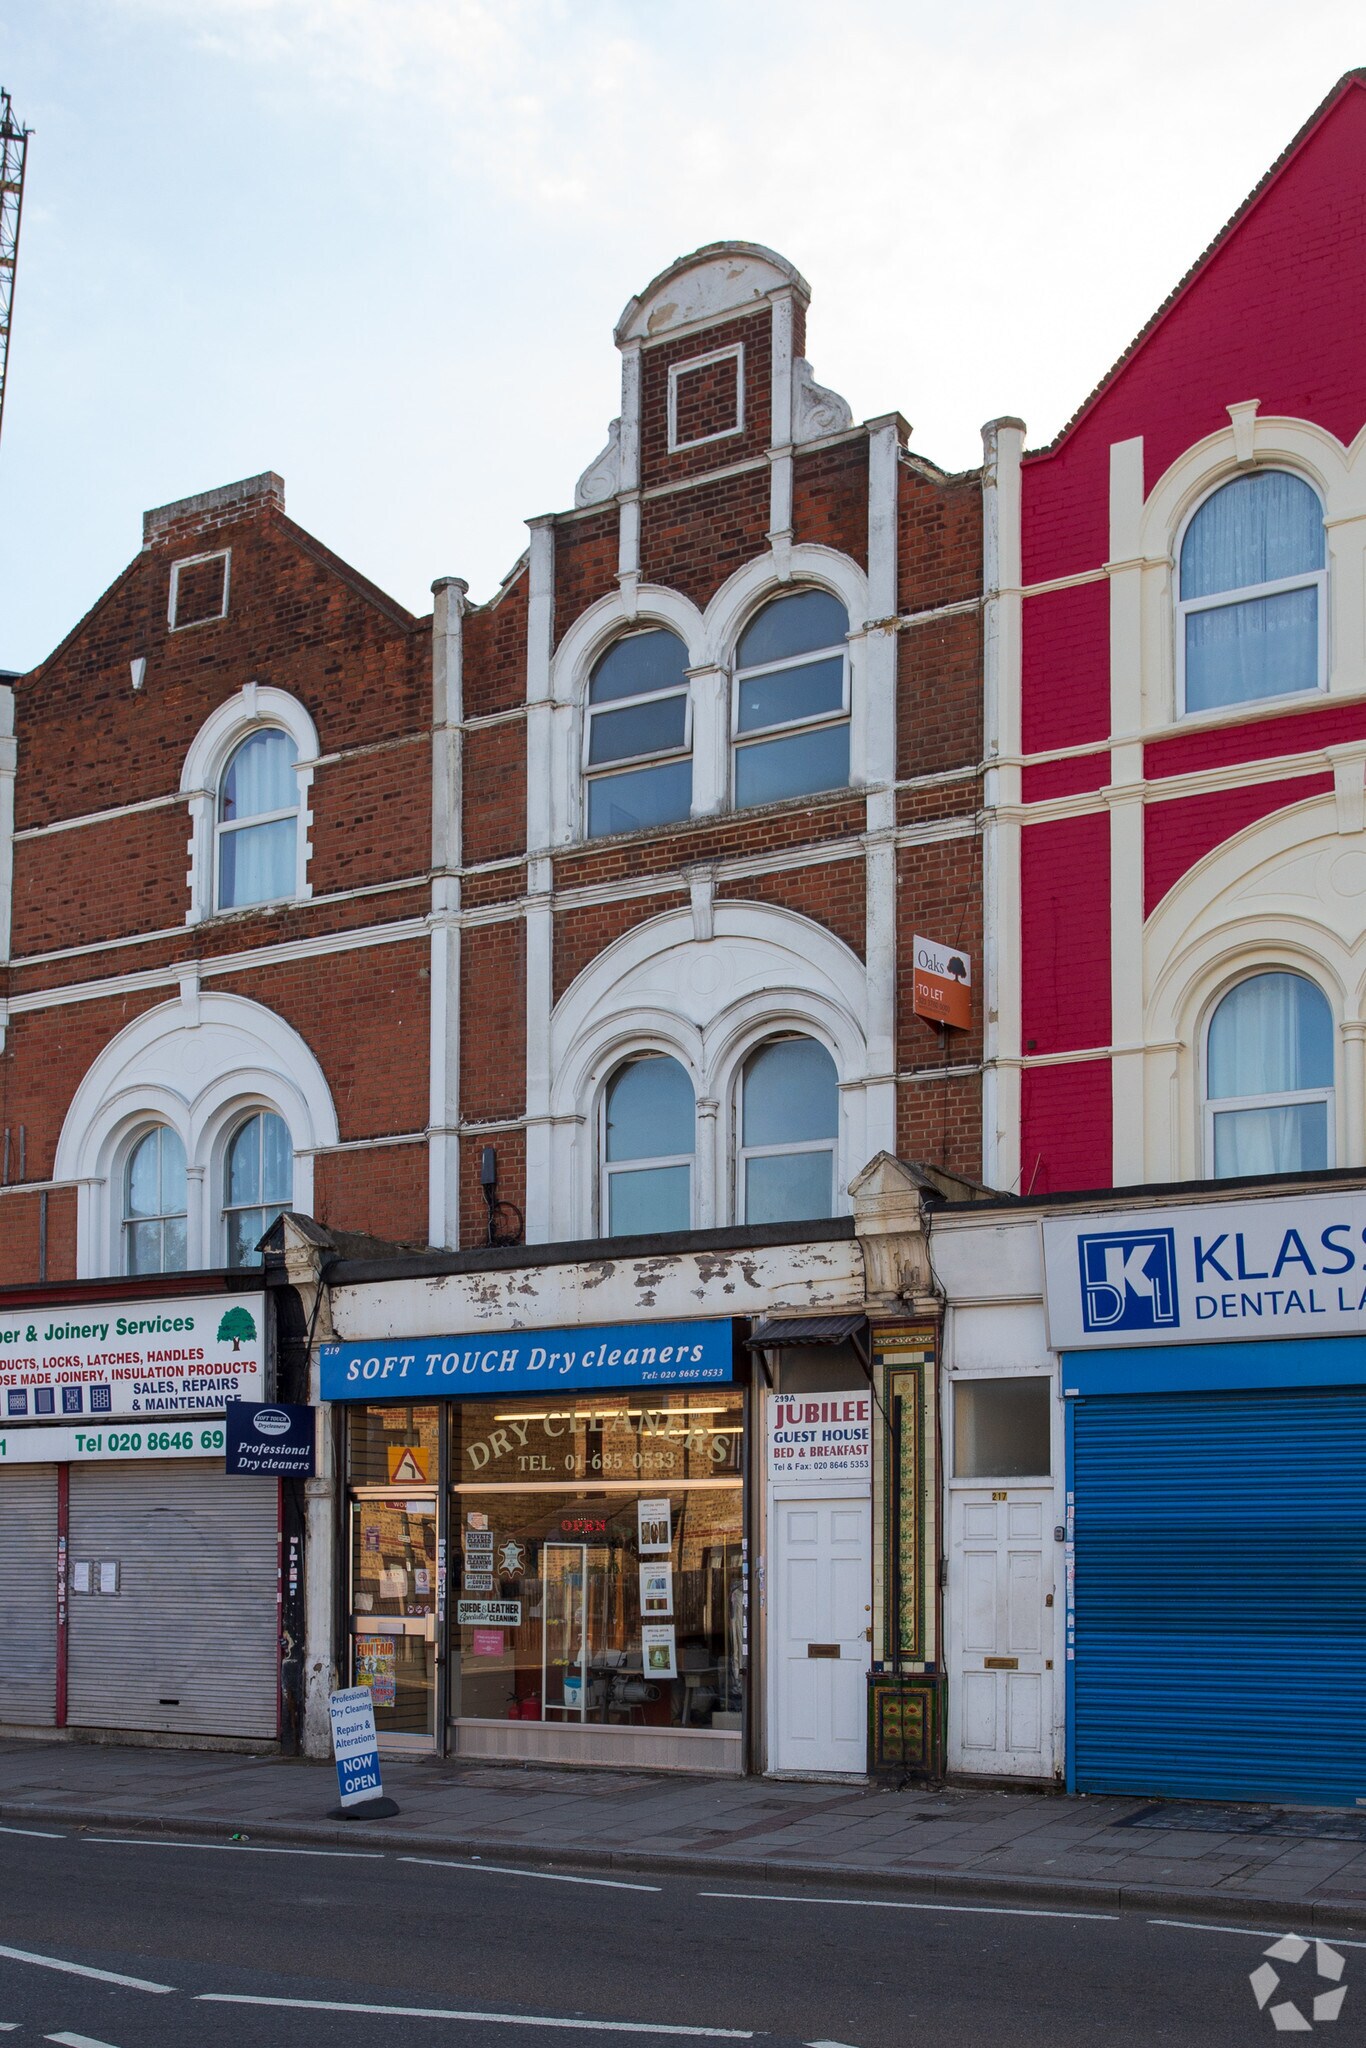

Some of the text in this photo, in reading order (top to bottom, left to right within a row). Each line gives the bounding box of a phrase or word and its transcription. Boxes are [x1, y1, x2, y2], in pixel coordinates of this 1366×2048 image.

[918, 950, 945, 974] Oaks
[918, 984, 944, 1002] TO LET
[1193, 1224, 1366, 1283] KLAS
[1195, 1289, 1326, 1320] DENTAL
[26, 1325, 37, 1341] &
[45, 1322, 109, 1341] Joinery
[116, 1316, 195, 1336] Services
[43, 1355, 84, 1369] LOCKS,
[87, 1352, 143, 1366] LATCHES,
[147, 1348, 204, 1362] HANDLES
[324, 1347, 340, 1355] 219
[21, 1373, 51, 1384] MADE
[55, 1370, 107, 1383] JOINERY,
[112, 1365, 184, 1380] INSULATION
[188, 1361, 257, 1376] PRODUCTS
[346, 1356, 415, 1381] SOFT
[425, 1349, 520, 1376] TOUCH
[642, 1368, 723, 1379] Tel: 020 8685 0533
[134, 1378, 239, 1395] SALES, REPAIRS
[132, 1399, 141, 1411] &
[774, 1400, 869, 1429] JUBILEE
[75, 1434, 102, 1452] Tel
[108, 1433, 142, 1451] 020
[147, 1431, 193, 1450] 8646
[466, 1408, 731, 1471] DRY CLEANERS
[773, 1428, 869, 1443] GUEST HOUSE
[237, 1442, 310, 1456] Professional
[773, 1444, 869, 1459] BED & BREAKFAST
[518, 1451, 675, 1471] TEL. 01-685 0533
[773, 1463, 785, 1471] Tel
[795, 1462, 812, 1470] Fax:
[829, 1461, 848, 1469] 8646
[850, 1460, 869, 1468] 5353
[561, 1519, 606, 1531] OPEN
[460, 1603, 519, 1614] SUEDE & LEATHER
[489, 1614, 518, 1622] CLEANING
[356, 1642, 394, 1656] FUN FAIR
[332, 1689, 369, 1705] Professional
[331, 1703, 372, 1718] Dry Cleaning
[336, 1720, 371, 1736] Repairs &
[336, 1733, 375, 1749] Alterations
[343, 1754, 373, 1774] NOW
[345, 1773, 377, 1792] OPEN
